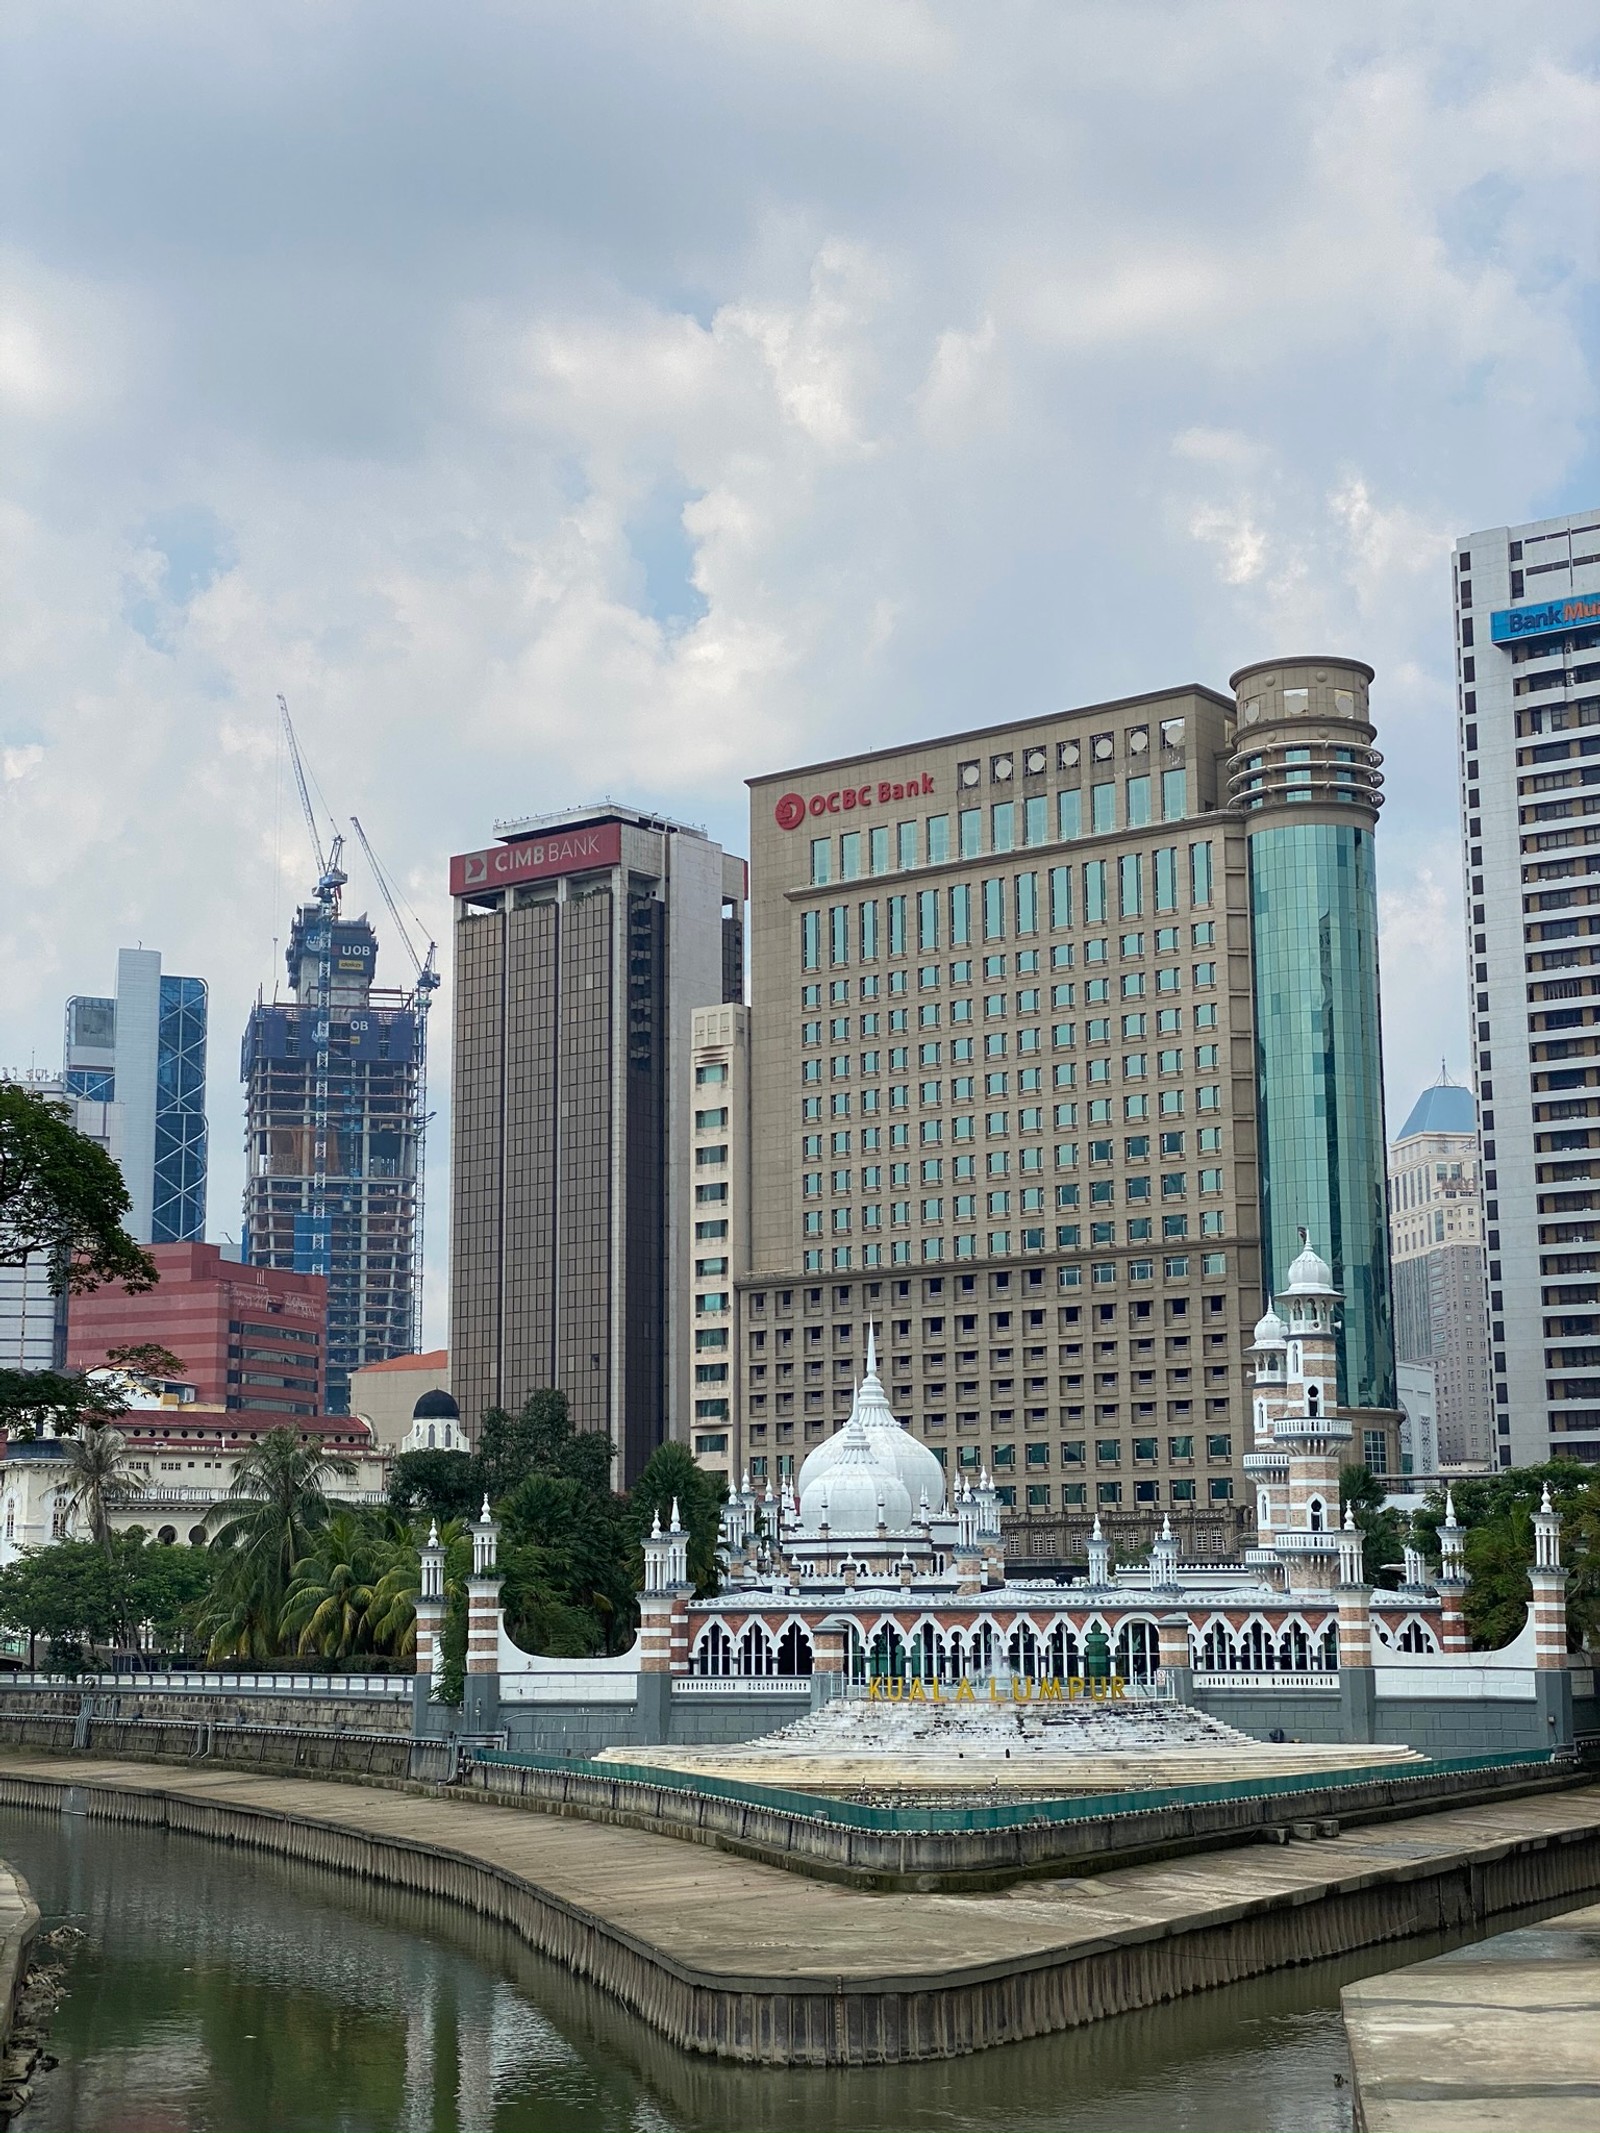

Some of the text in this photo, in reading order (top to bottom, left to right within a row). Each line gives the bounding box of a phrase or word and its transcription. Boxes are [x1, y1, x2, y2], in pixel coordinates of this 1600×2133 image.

[1510, 601, 1600, 632] Bank Mu
[809, 772, 934, 816] OCBC Bank
[495, 834, 600, 872] CIMB BANK
[342, 945, 370, 956] UOB
[869, 1676, 1127, 1702] KUALA LUMPUR
